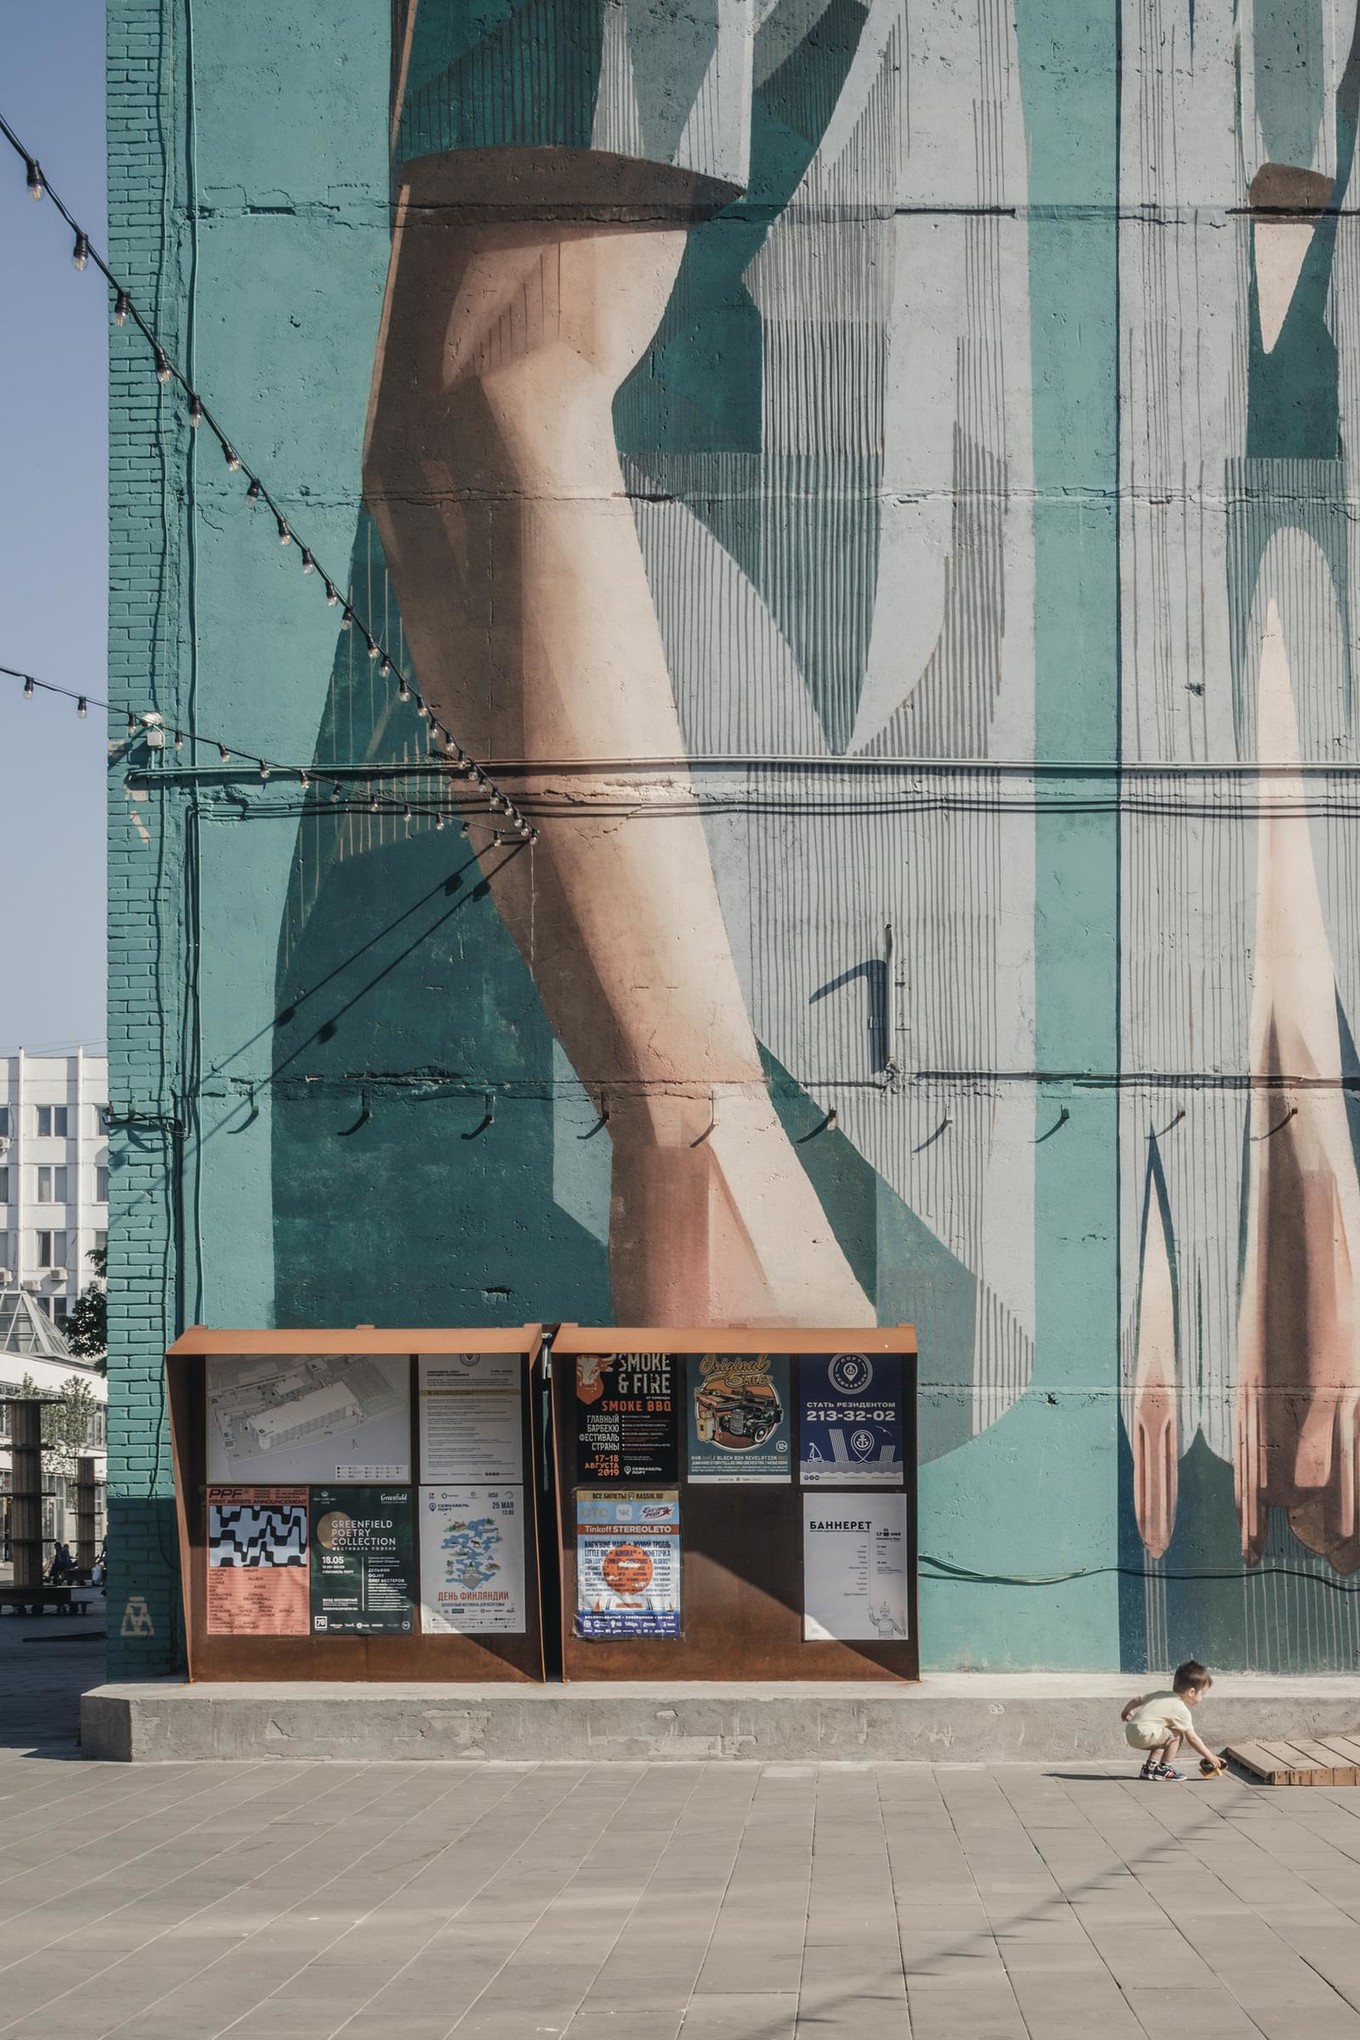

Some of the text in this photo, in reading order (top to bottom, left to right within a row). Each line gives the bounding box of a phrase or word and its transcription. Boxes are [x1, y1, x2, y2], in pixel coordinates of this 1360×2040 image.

[618, 1353, 671, 1372] SMOKE
[699, 1353, 771, 1376] Original
[618, 1373, 671, 1394] & FIRE
[601, 1400, 672, 1412] SMOKE BBQ
[586, 1414, 620, 1424] ГЛАВНЫЙ
[806, 1410, 896, 1421] 213-32-02
[587, 1424, 620, 1433] БАРБЕКЮ
[579, 1433, 620, 1442] ФЕСТИВАЛЬ
[591, 1442, 620, 1451] СТРАНЫ
[594, 1454, 619, 1462] 17-18
[209, 1488, 243, 1499] PPF
[331, 1520, 393, 1529] GREENFIELD
[584, 1525, 672, 1533] Tinkoff STEREOLETO
[809, 1521, 872, 1530] БАННЕРЕТ
[331, 1528, 371, 1537] POETRY
[331, 1537, 396, 1546] COLLECTION
[321, 1556, 344, 1565] 18.05
[437, 1591, 509, 1602] ДЕНЬ ФИНЛЯНДИИ
